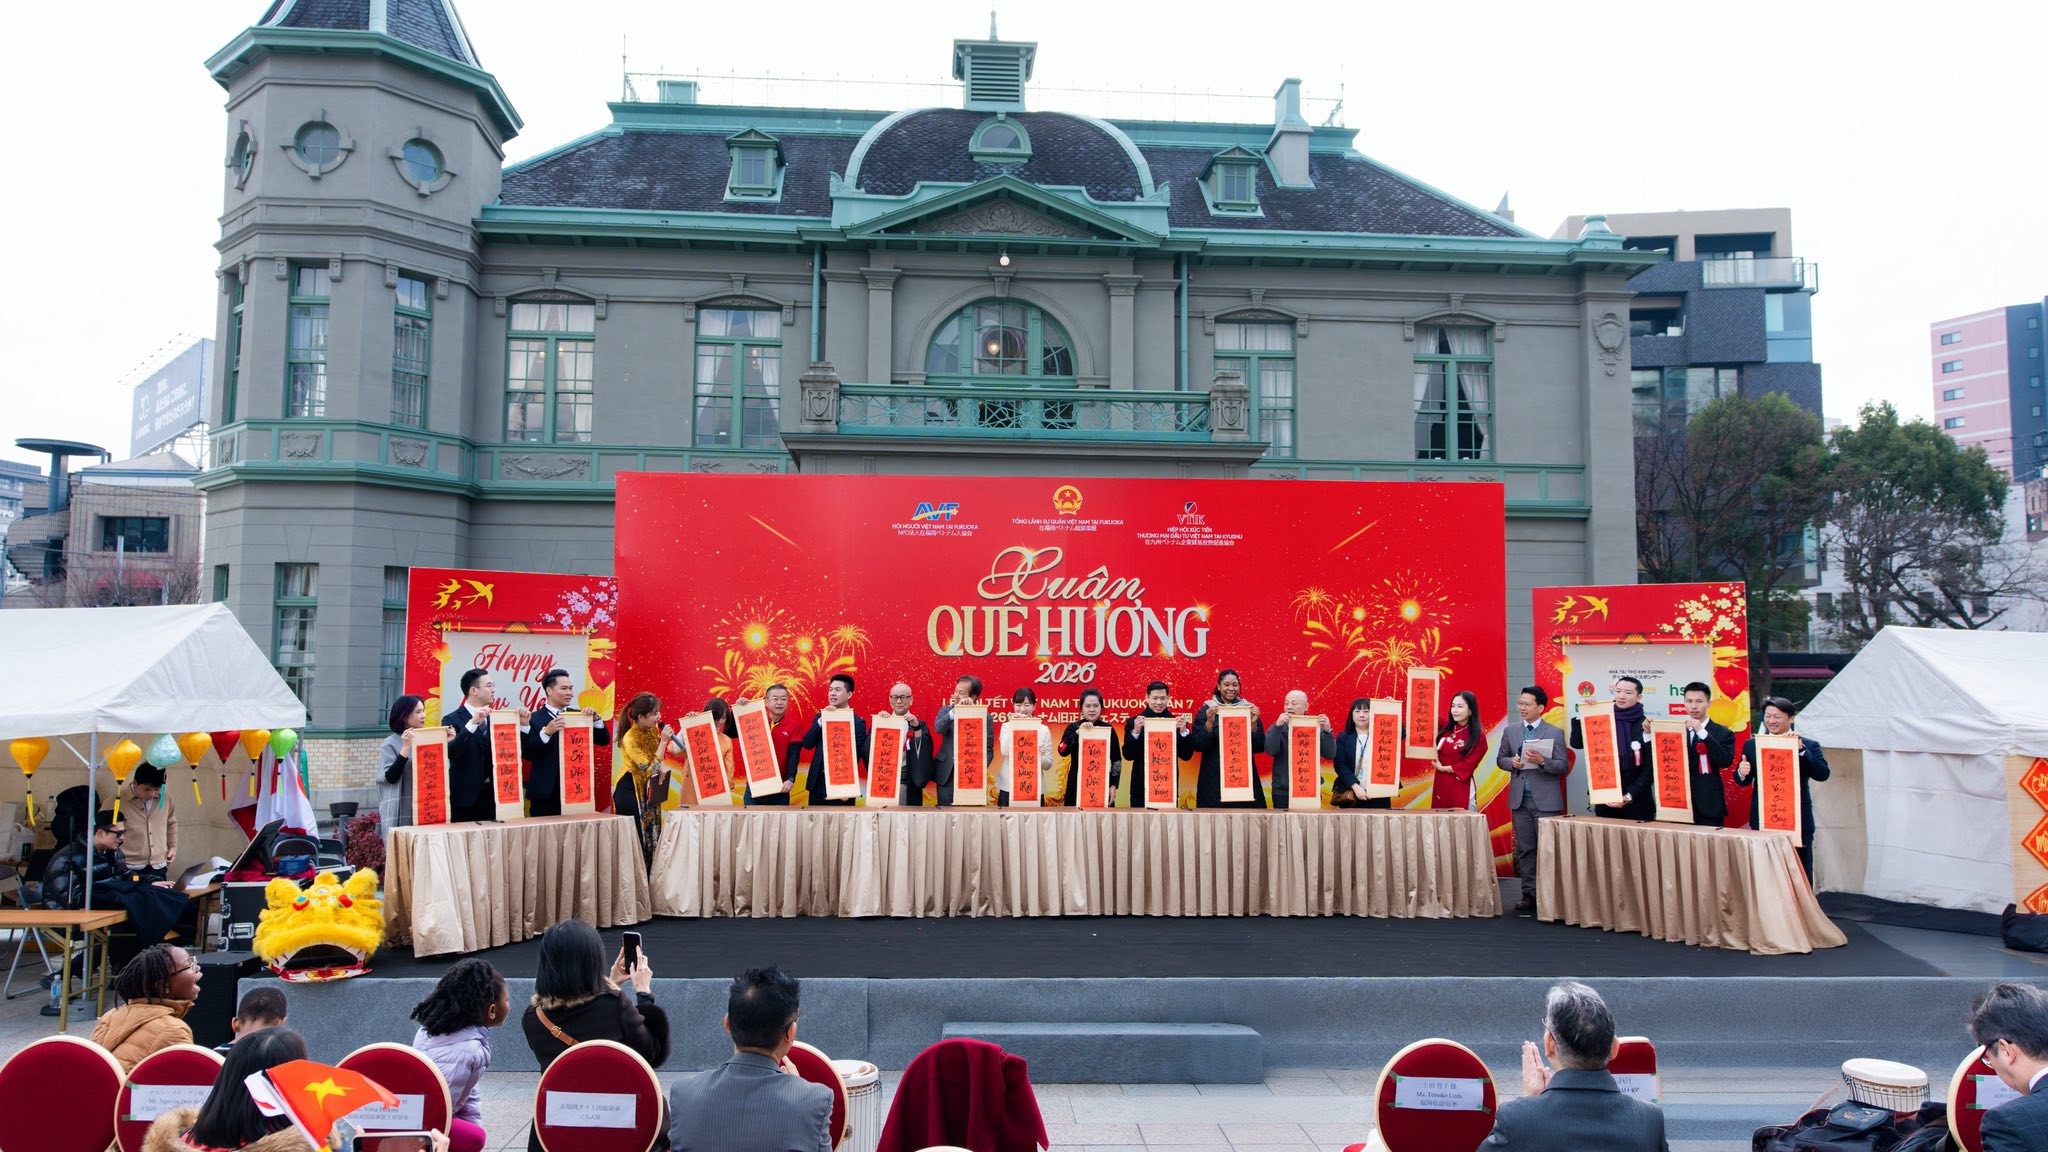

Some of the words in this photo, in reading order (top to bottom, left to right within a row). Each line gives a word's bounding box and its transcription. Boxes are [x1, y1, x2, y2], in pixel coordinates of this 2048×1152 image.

[911, 502, 960, 521] AVF
[977, 546, 1146, 601] Xuân
[927, 596, 1029, 658] QUÊ
[1036, 599, 1211, 658] HƯƠNG
[474, 644, 557, 683] Happy
[1034, 661, 1098, 684] 2026
[987, 695, 1008, 708] TẾT
[1041, 699, 1070, 709] NAM
[1102, 699, 1148, 709] UKUOK
[1186, 699, 1194, 709] 7
